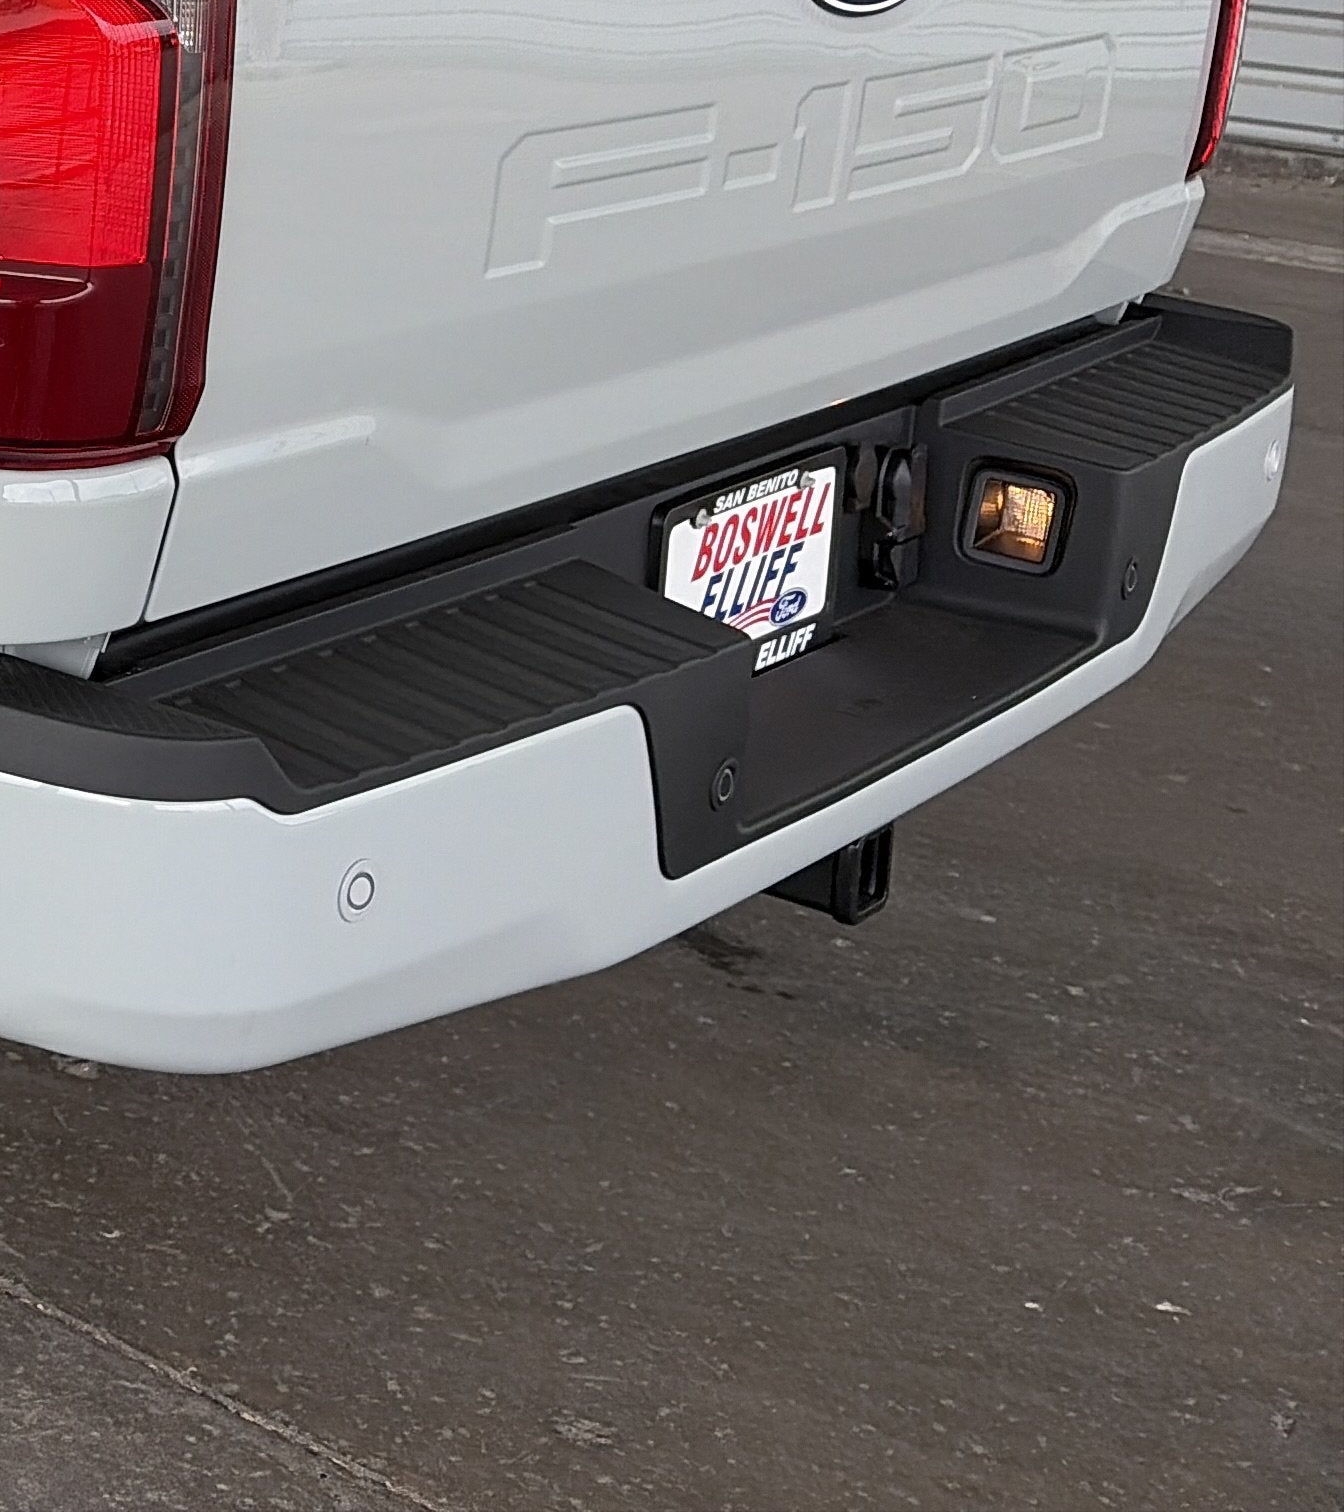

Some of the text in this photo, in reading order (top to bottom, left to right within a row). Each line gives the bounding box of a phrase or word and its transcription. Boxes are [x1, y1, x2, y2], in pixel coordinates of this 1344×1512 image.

[484, 32, 1116, 281] F-150
[713, 468, 800, 514] SAN BENITO
[691, 482, 832, 583] BOSWELL
[700, 541, 805, 622] ELLIFF
[775, 594, 802, 622] Ford
[754, 622, 817, 672] ELLIFF
